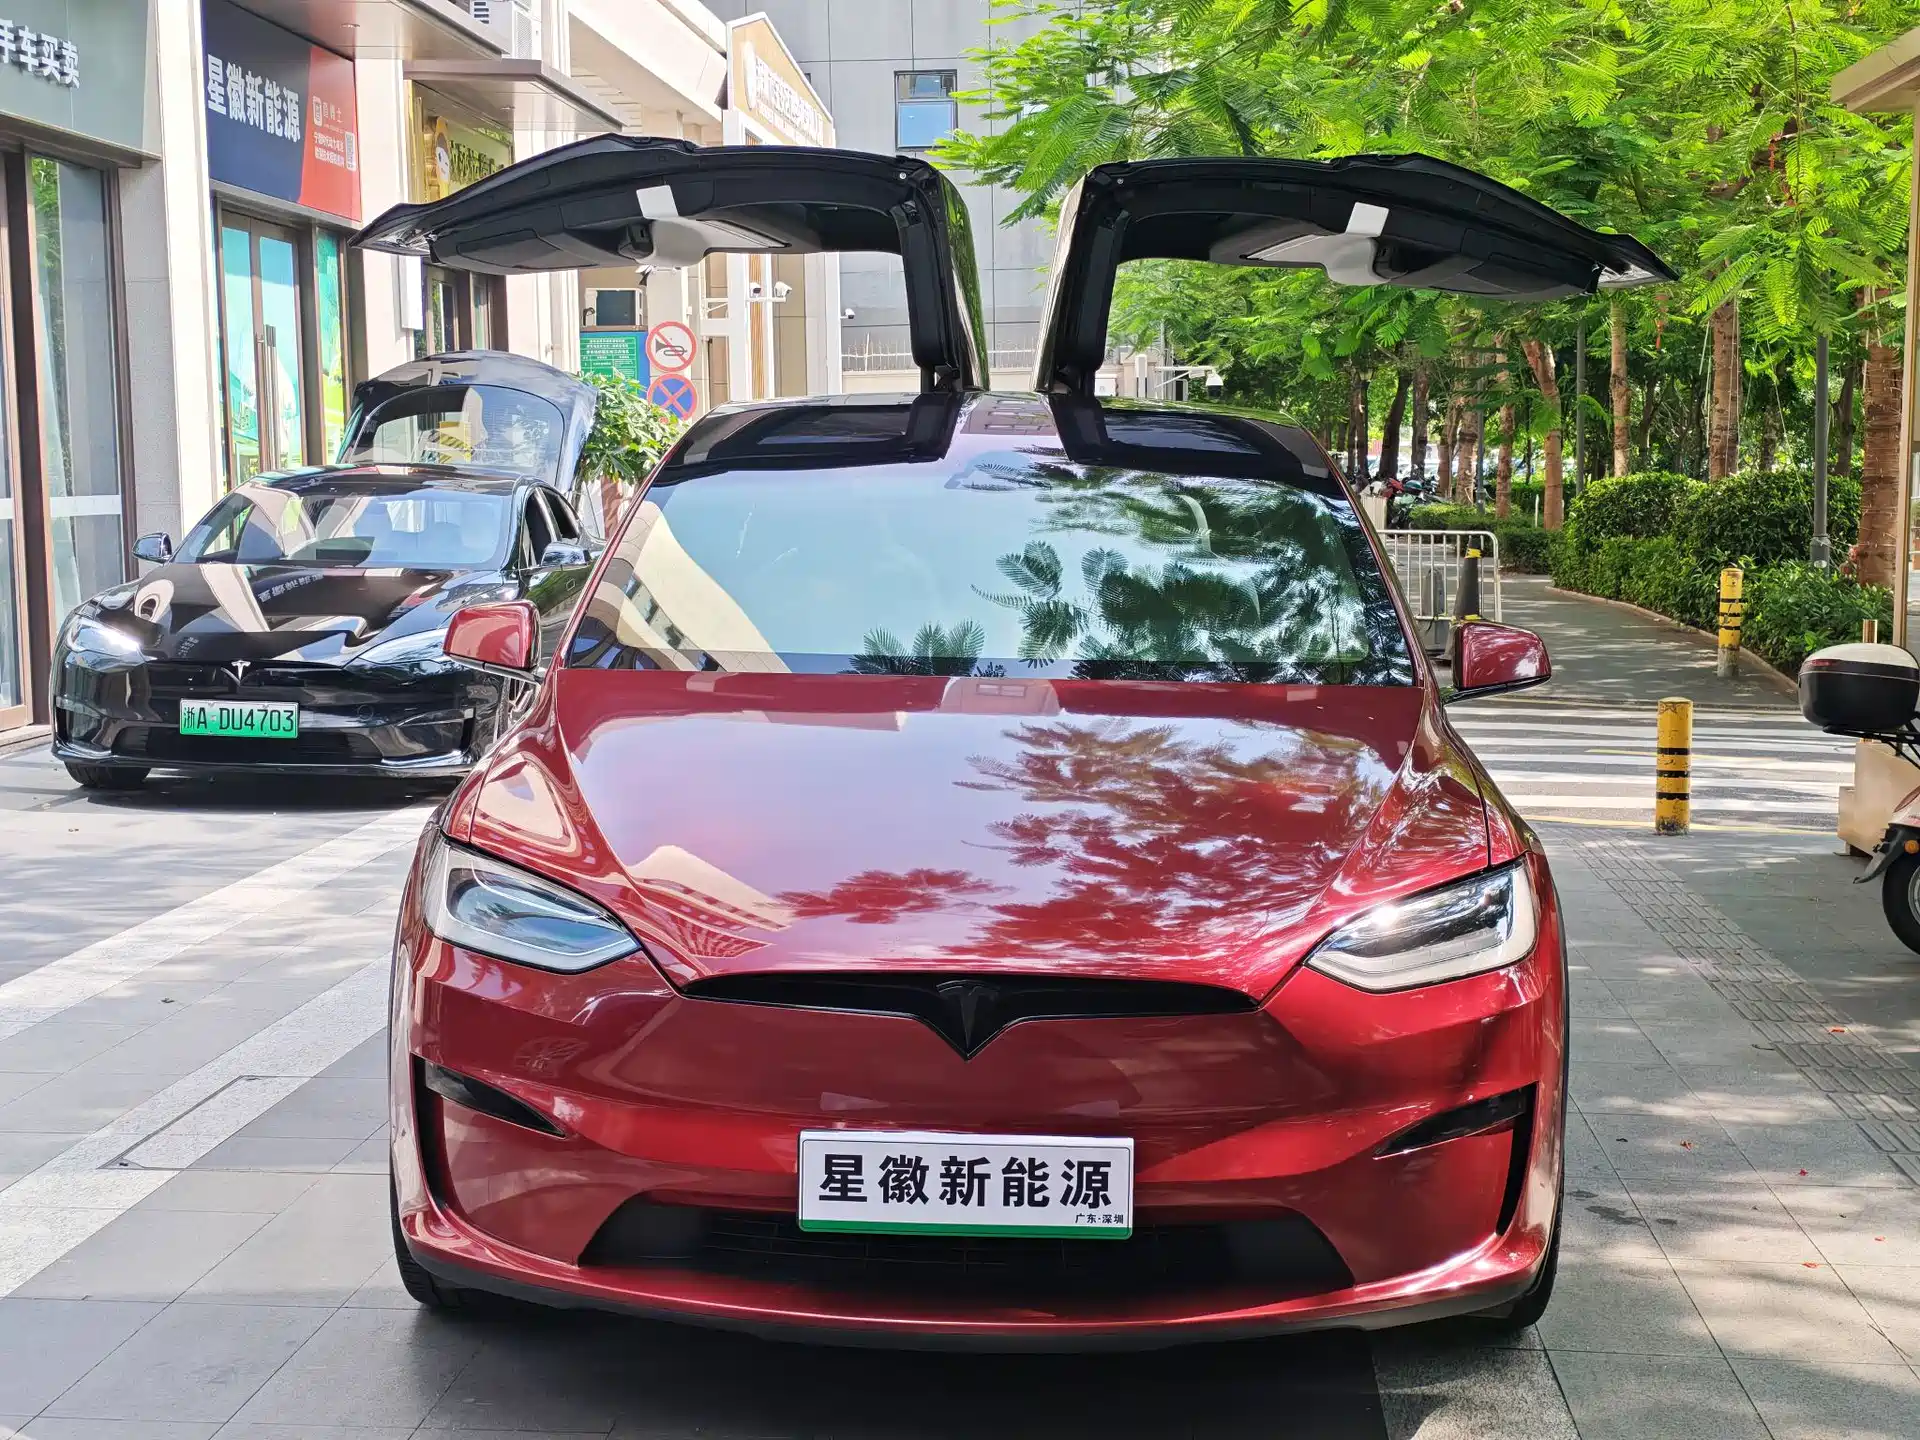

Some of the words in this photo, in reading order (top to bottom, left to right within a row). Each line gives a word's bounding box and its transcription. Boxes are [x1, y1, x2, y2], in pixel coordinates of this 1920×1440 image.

[207, 54, 301, 142] 星徽新能源
[818, 1153, 1113, 1210] 星徽新能源
[1075, 1213, 1124, 1224] 广东·深圳
